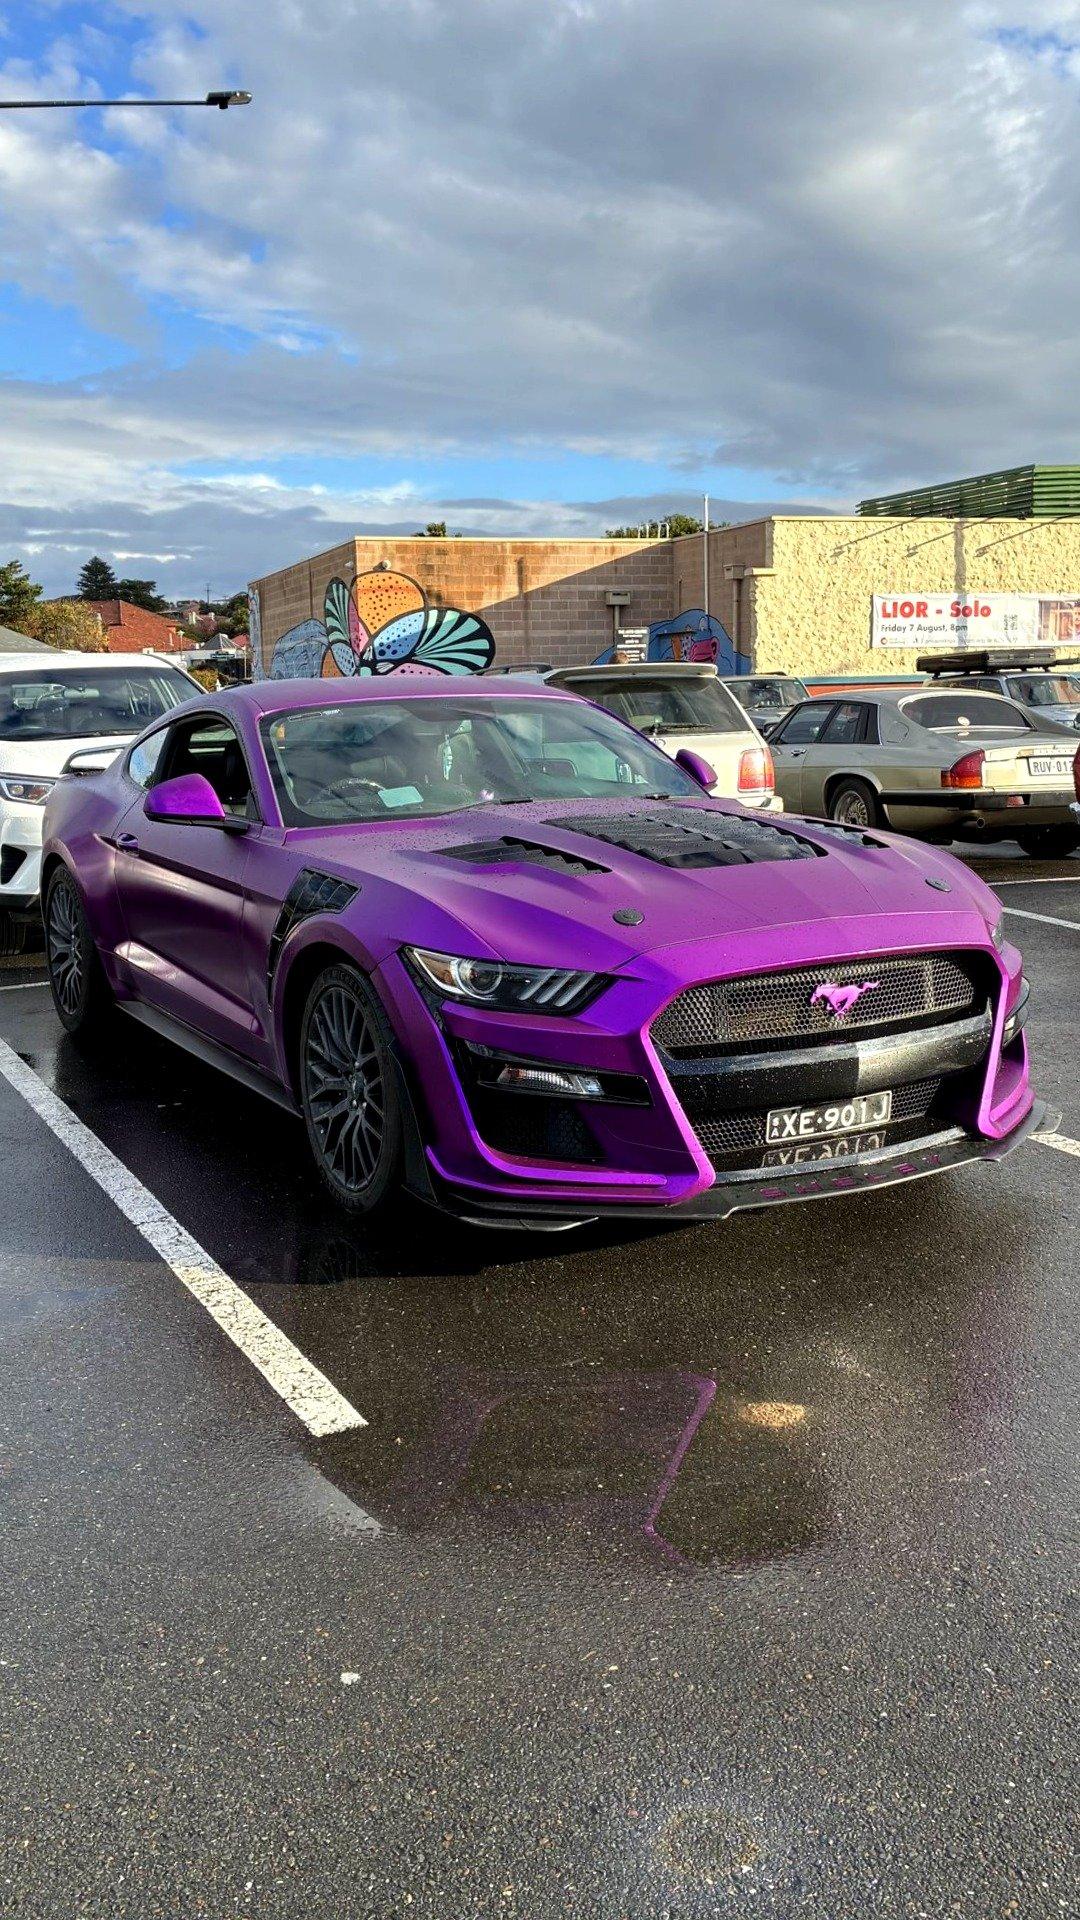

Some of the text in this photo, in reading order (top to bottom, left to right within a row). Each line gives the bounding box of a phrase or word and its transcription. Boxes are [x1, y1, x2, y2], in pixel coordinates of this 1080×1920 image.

[881, 601, 928, 618] LIOR
[950, 600, 991, 618] Solo
[881, 624, 906, 633] Friday
[916, 624, 947, 633] August,
[950, 624, 968, 632] 8pm
